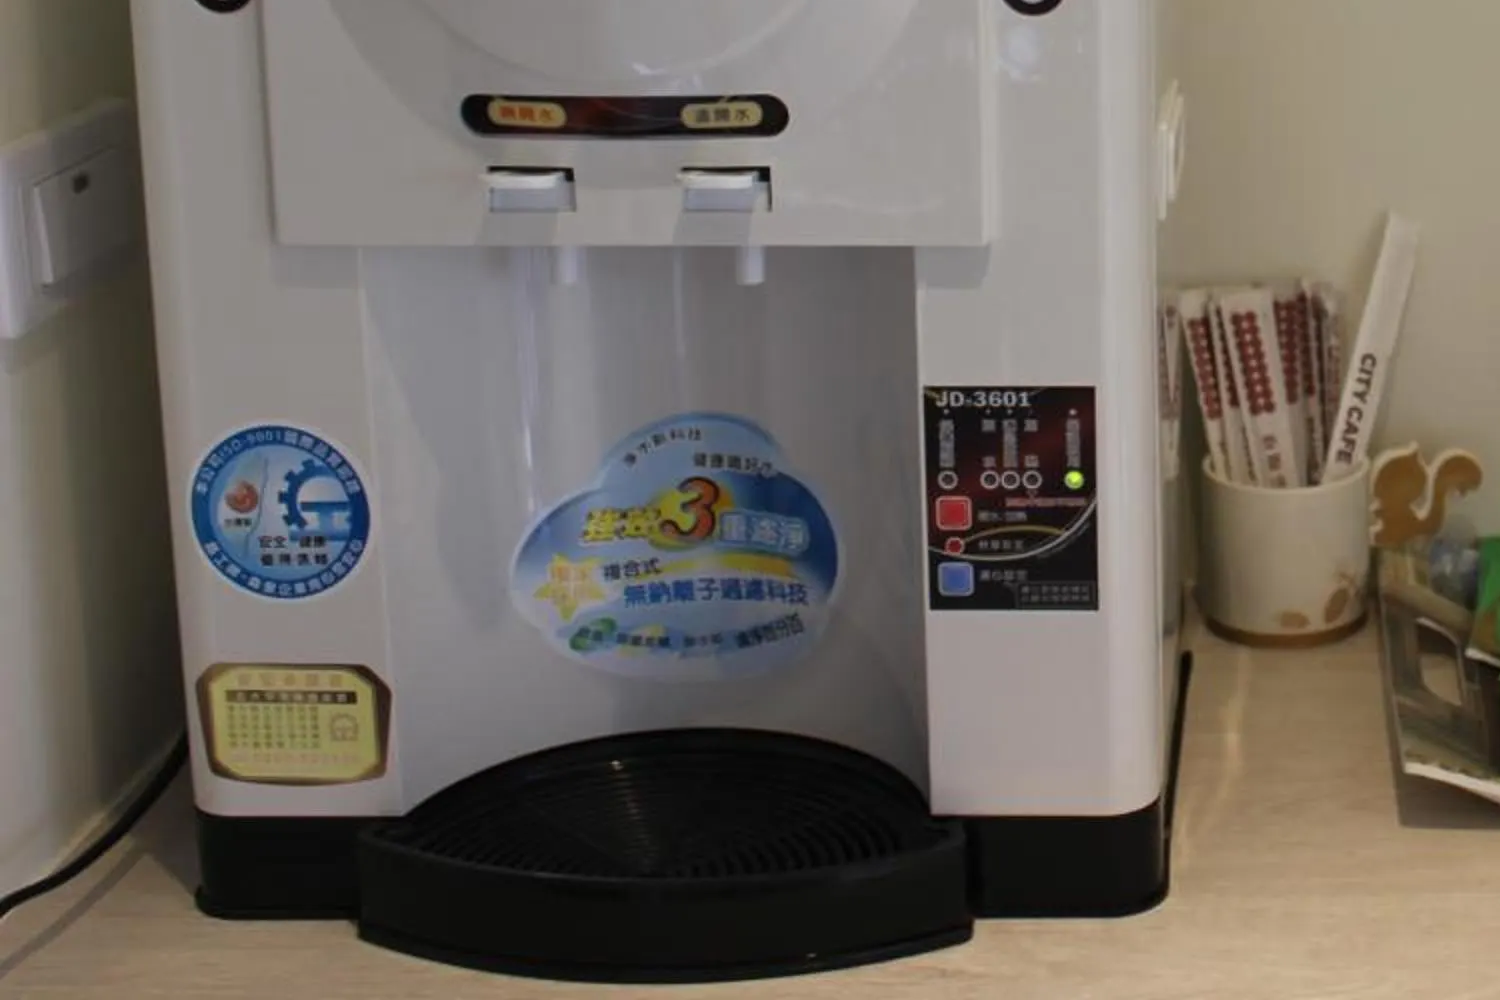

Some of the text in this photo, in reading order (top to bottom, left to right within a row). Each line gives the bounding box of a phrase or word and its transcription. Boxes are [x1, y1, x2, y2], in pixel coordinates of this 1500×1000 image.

[936, 391, 1032, 407] JD-3601
[1335, 353, 1377, 465] CITY CAFE
